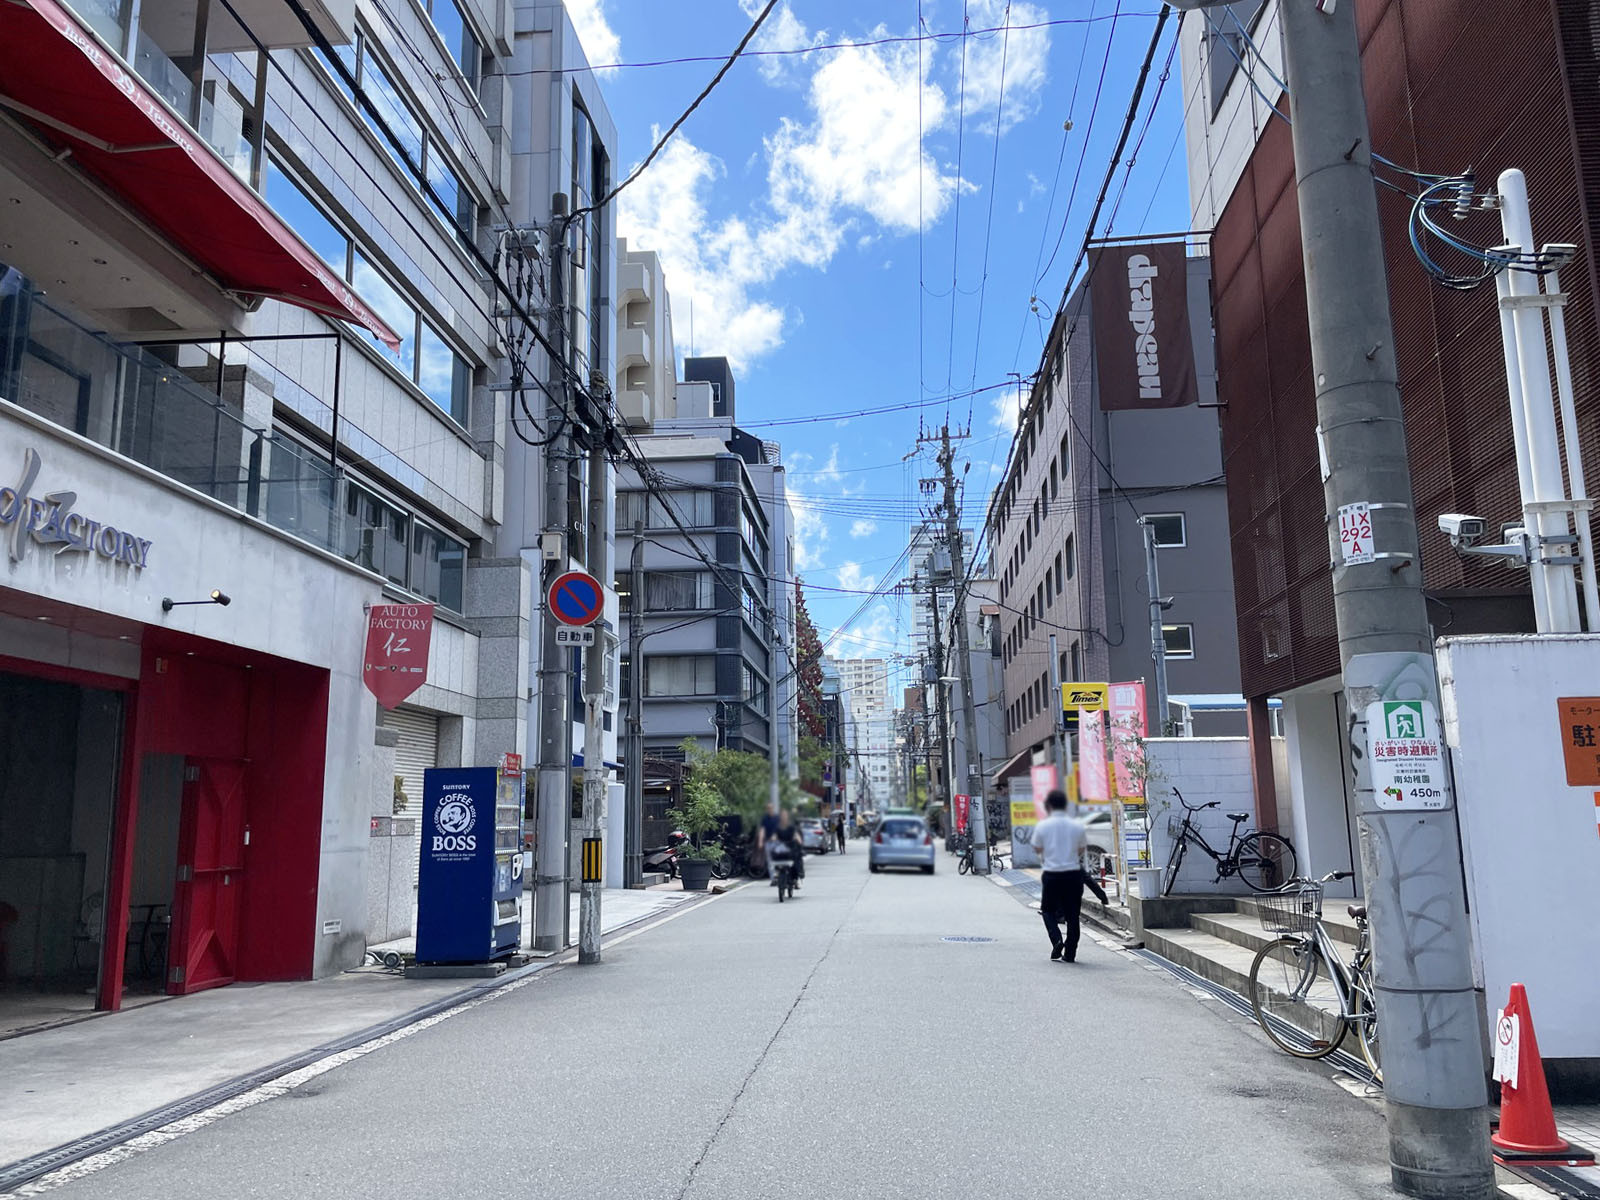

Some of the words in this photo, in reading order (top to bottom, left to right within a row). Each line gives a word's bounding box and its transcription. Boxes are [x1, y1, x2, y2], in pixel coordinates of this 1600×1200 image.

[1127, 253, 1162, 399] drapeau
[26, 496, 153, 568] FACTORY
[1341, 526, 1371, 543] 292
[1352, 541, 1362, 555] A
[381, 605, 418, 617] AUTO
[371, 618, 428, 631] FACTORY
[557, 630, 593, 642] 自動車
[383, 631, 412, 657] 仁
[1070, 691, 1103, 703] Times
[1572, 724, 1600, 748] 駐
[1375, 745, 1438, 757] 災害時避難所
[439, 793, 473, 806] COFFEE
[1410, 788, 1441, 798] 450m
[432, 835, 477, 851] BOSS
